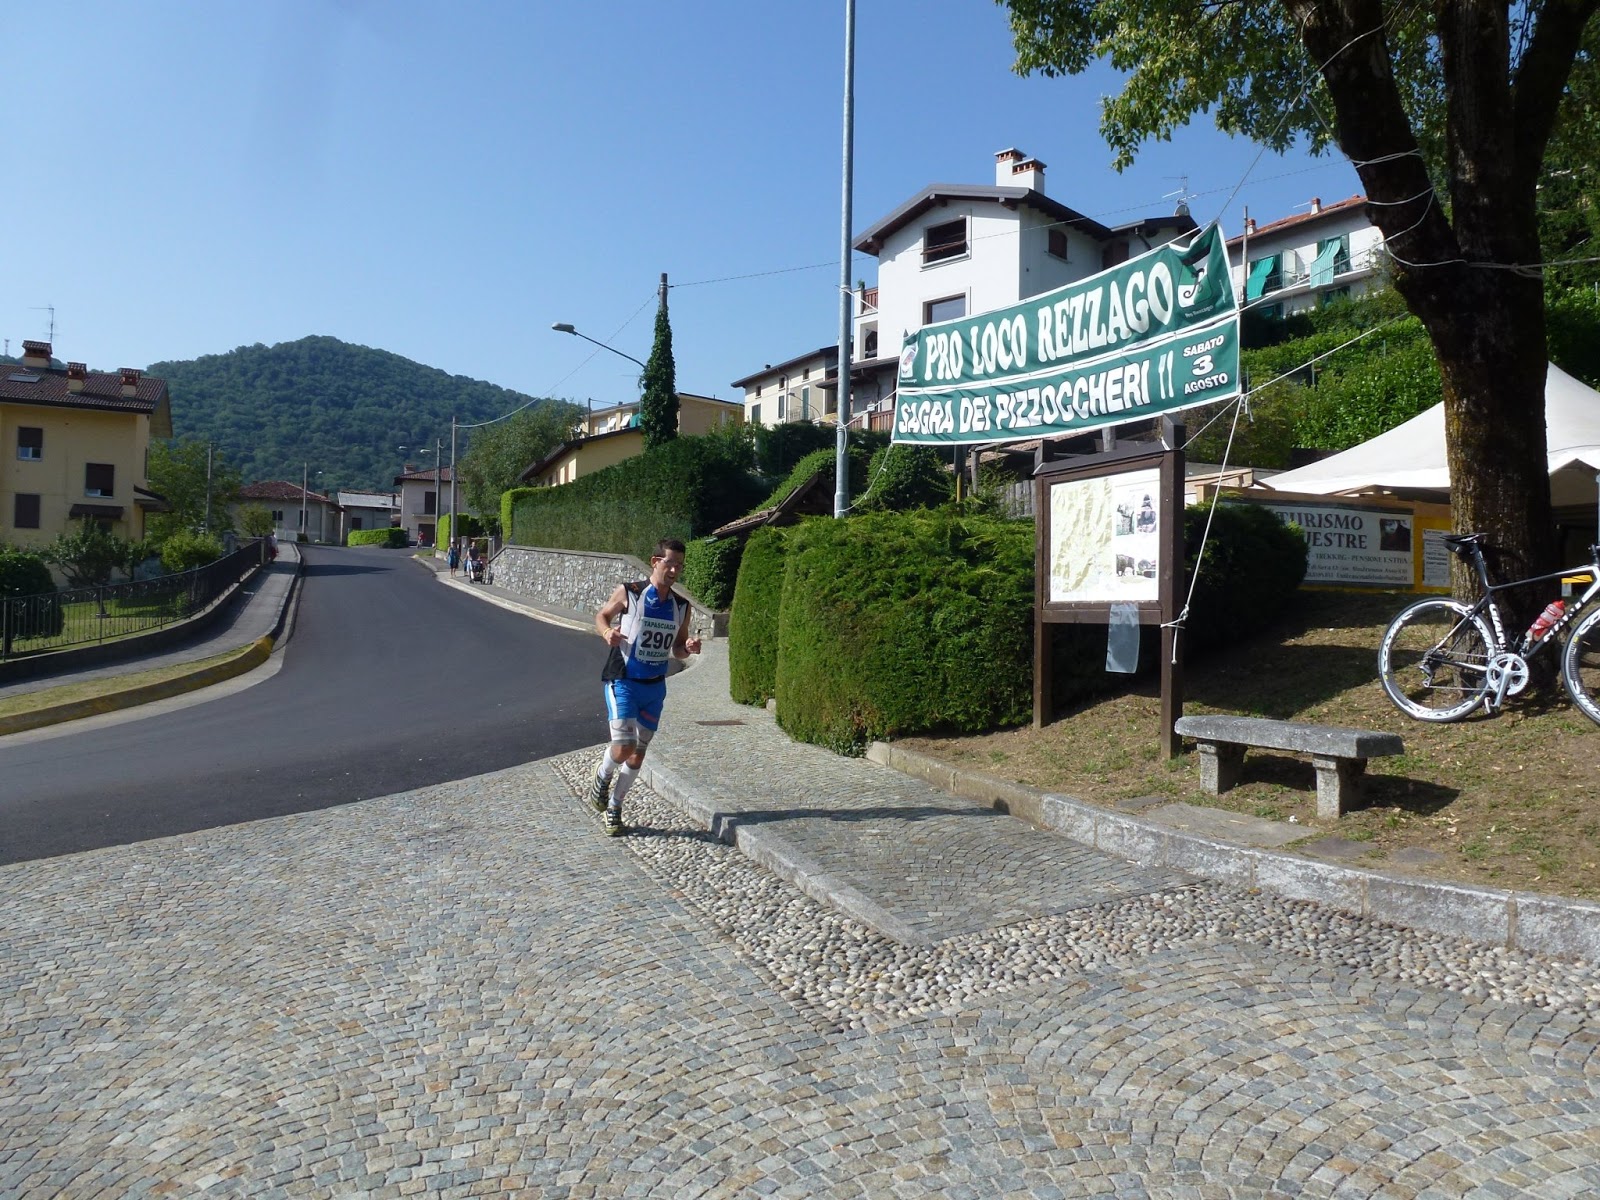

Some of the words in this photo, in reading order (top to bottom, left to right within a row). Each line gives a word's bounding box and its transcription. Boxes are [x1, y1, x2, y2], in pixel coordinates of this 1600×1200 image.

[925, 330, 963, 381] PRO
[970, 314, 1027, 375] LOCO
[1038, 262, 1173, 362] REZZAGO
[1183, 334, 1224, 357] SABATO
[1192, 354, 1214, 376] 3
[1184, 372, 1228, 395] AGOSTO
[898, 400, 954, 435] SAGRA
[959, 395, 991, 433] DEI
[996, 359, 1150, 430] PIZZOCCHERI
[643, 620, 676, 630] TAPASCIADA
[641, 630, 673, 650] 290
